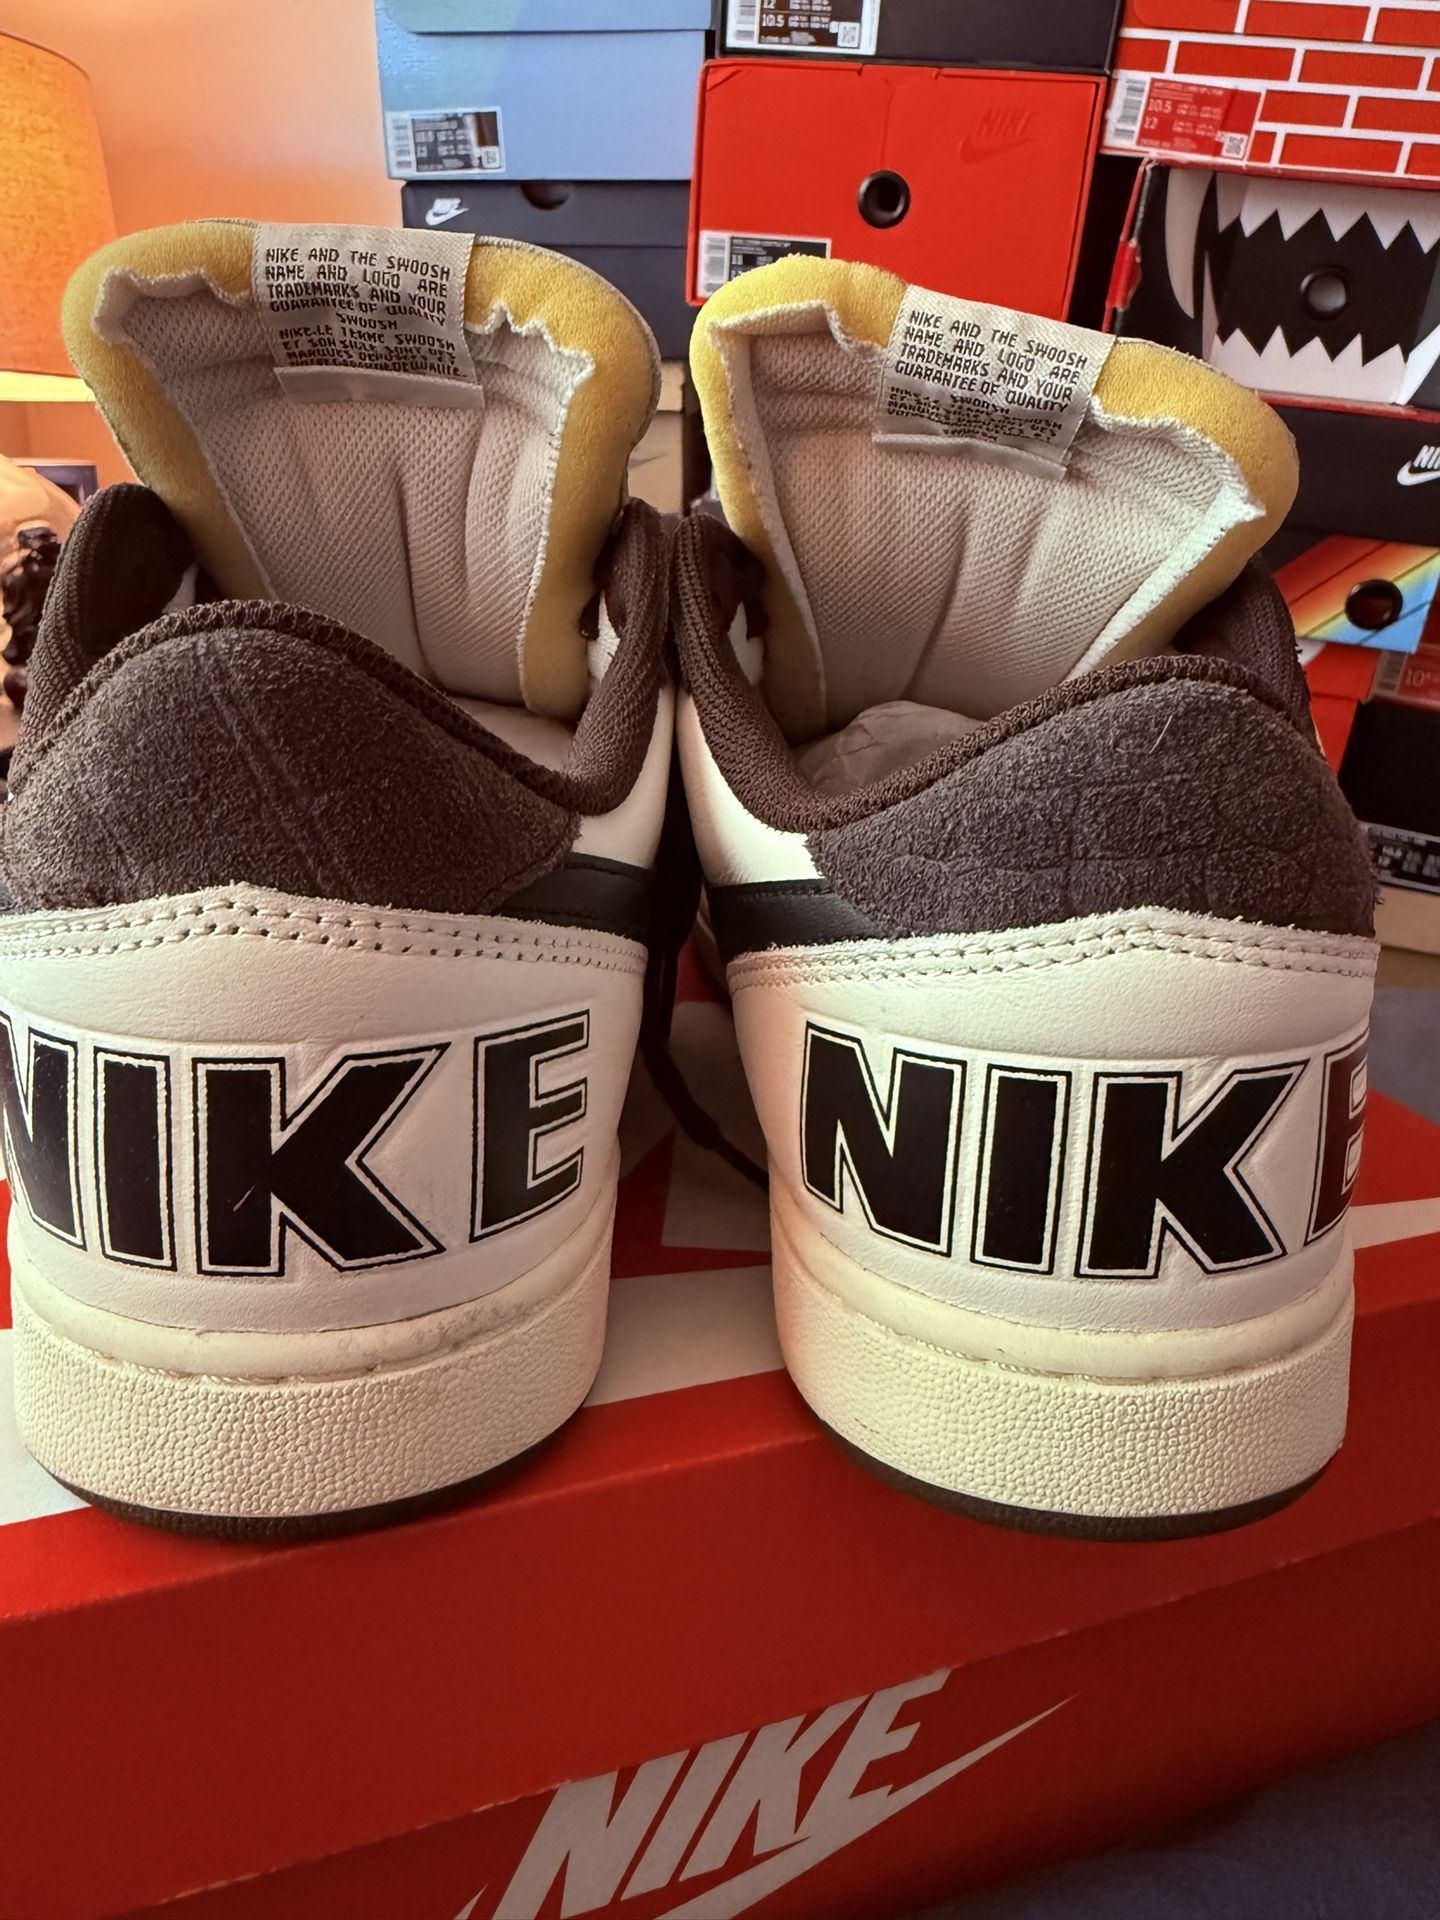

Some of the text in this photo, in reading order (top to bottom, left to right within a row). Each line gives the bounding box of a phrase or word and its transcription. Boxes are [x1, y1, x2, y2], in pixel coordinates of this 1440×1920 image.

[265, 265, 448, 298] NAME AND LOGO ARE
[266, 247, 450, 281] NIKE AND THE SWOOSH
[266, 282, 447, 315] TRADEMARKS AND YOUR
[359, 302, 378, 313] OF
[904, 326, 1081, 385] NAME AND LOGO ARE
[910, 310, 1088, 369] NIKE AND THE SWOOSH
[895, 360, 1069, 413] GUARANTEE OF QUALITY
[901, 342, 1073, 401] TRADEMARKS AND YOUR
[0, 1008, 591, 1277] NIKE
[799, 1020, 1370, 1280] NIKE
[488, 1666, 953, 1920] NIKE
